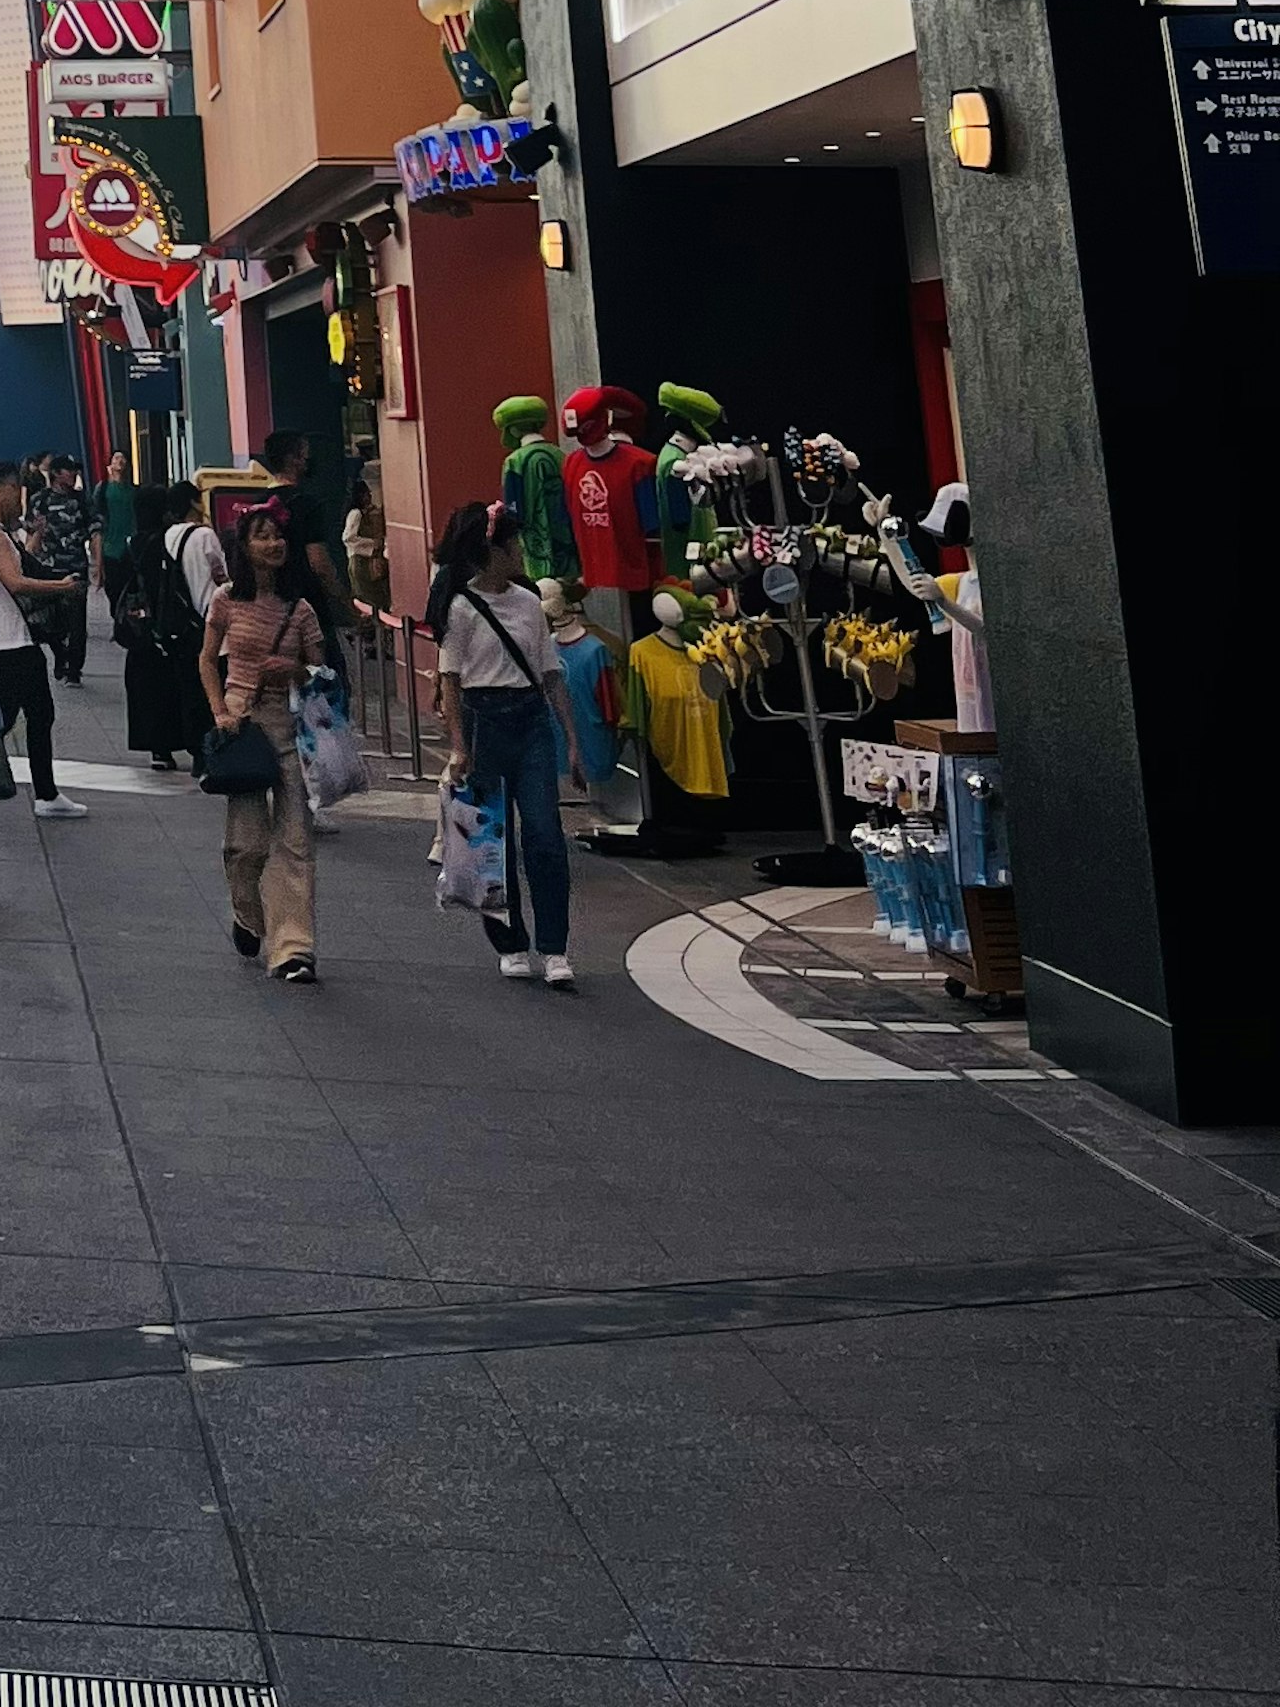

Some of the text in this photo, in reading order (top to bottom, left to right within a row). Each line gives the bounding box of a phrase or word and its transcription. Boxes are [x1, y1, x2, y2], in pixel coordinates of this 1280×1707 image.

[59, 72, 154, 85] MOS BURGER
[1221, 93, 1247, 104] Rest
[1226, 131, 1260, 142] Police
